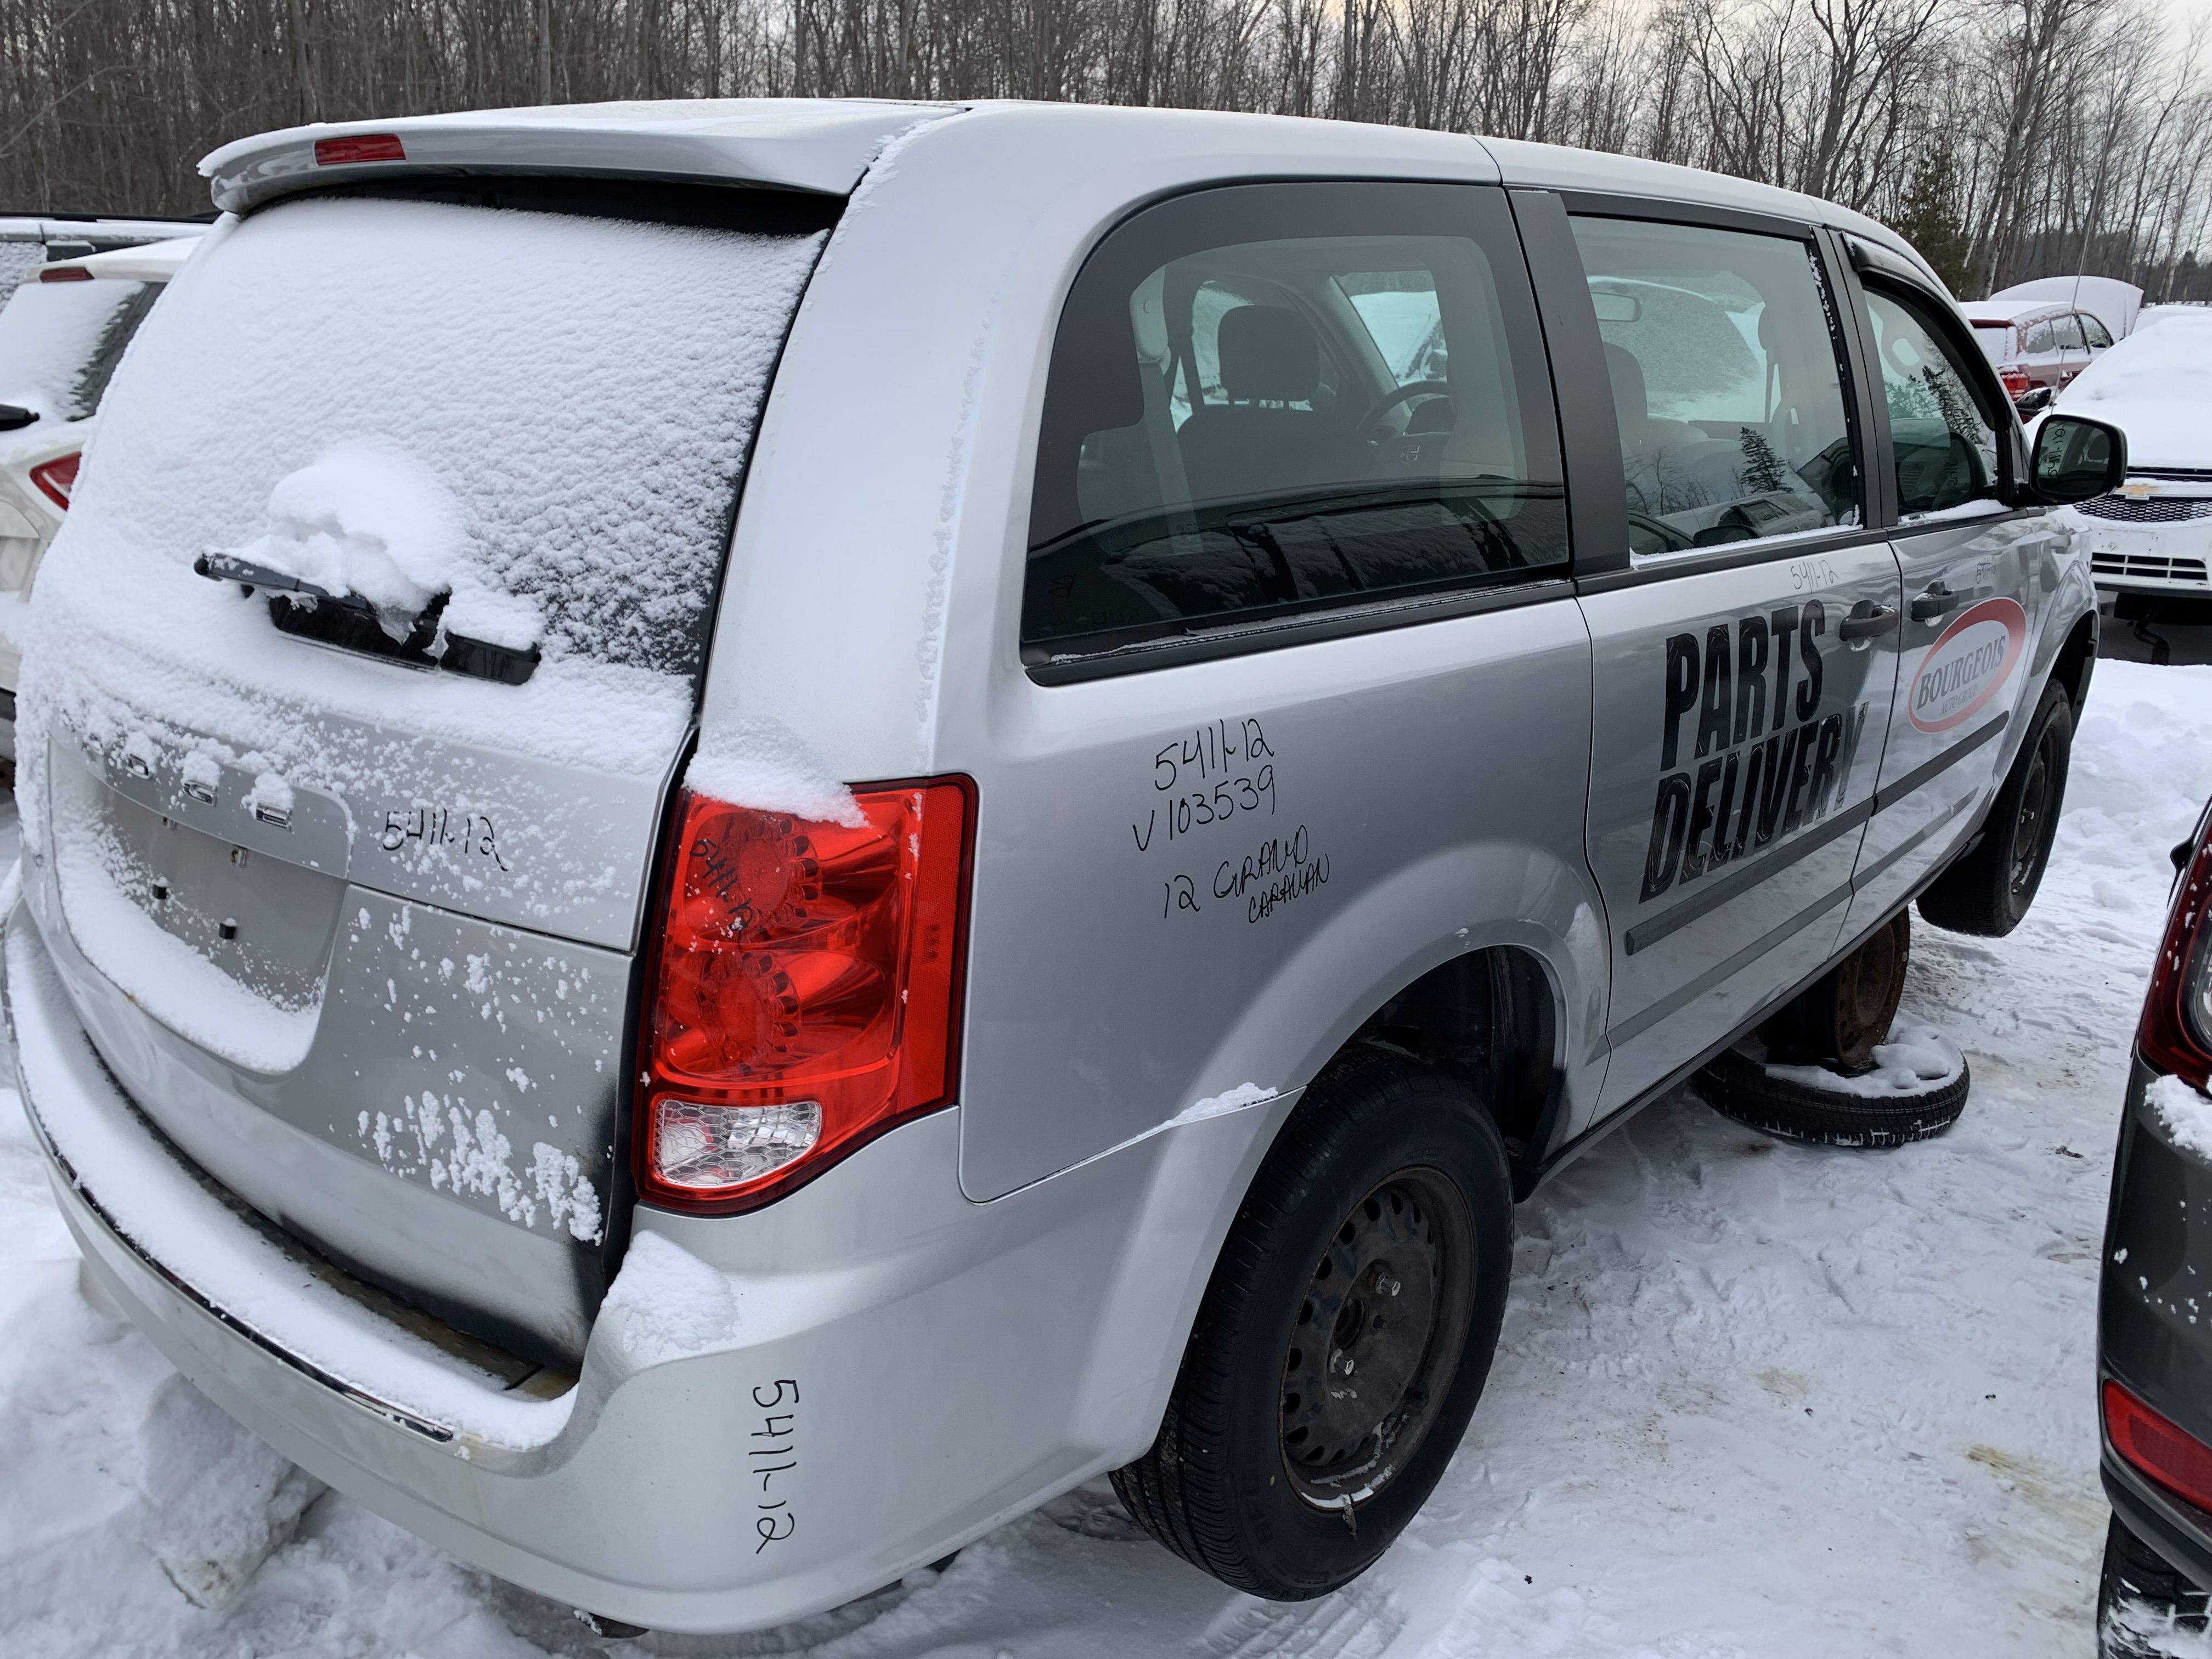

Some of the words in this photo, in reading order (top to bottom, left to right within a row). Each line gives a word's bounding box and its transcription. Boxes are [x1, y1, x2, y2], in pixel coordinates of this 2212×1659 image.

[1660, 599, 1825, 771] PARTS
[1916, 635, 2006, 710] BOURGEOIS
[1639, 701, 1869, 904] DELIVERY
[1164, 874, 1201, 919] 12
[1213, 825, 1308, 899] GRAND
[1248, 853, 1330, 924] CARAVAN
